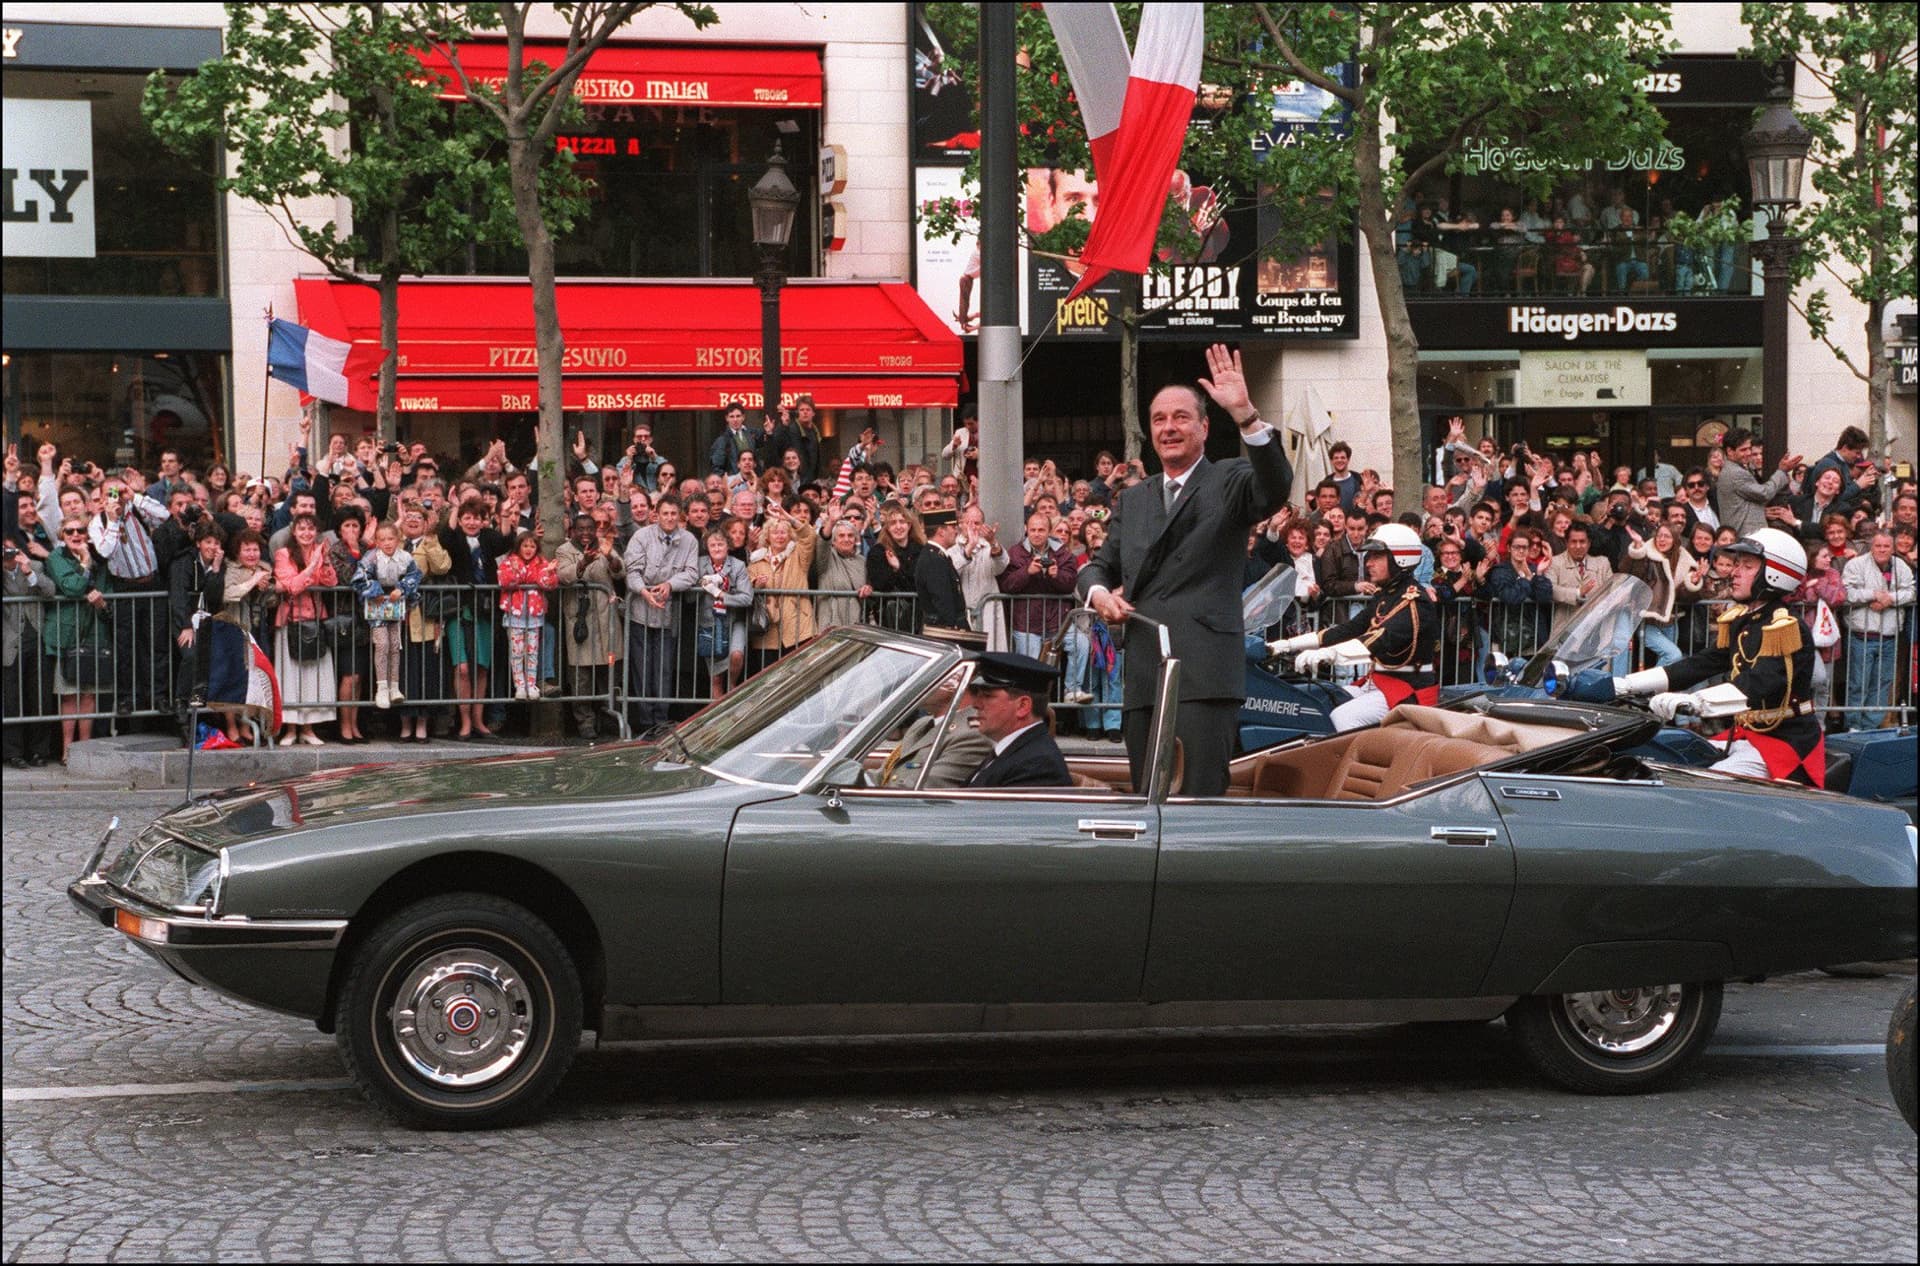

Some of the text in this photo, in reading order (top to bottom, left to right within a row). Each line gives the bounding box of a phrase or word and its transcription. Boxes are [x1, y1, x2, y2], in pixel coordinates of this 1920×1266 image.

[573, 79, 709, 100] BISTRO ITALIEN
[753, 88, 788, 101] TUBORG
[555, 136, 640, 155] PIZZA A
[3, 168, 89, 223] LY
[1210, 296, 1240, 310] nuit
[1256, 293, 1342, 311] Coups de feu
[1252, 311, 1345, 327] sur Broadway
[1511, 306, 1677, 340] Häagen-Dazs
[561, 348, 628, 367] ESUVIO
[695, 347, 809, 367] RISTORTE
[879, 355, 913, 367] TUBORG
[1545, 361, 1581, 370] SALON
[1585, 360, 1598, 370] DE
[400, 397, 438, 410] TUBORG
[501, 394, 531, 410] BAR
[586, 393, 666, 409] BRASSERIE
[867, 394, 903, 407] TUBORG
[1240, 697, 1300, 716] NDARMERIE
